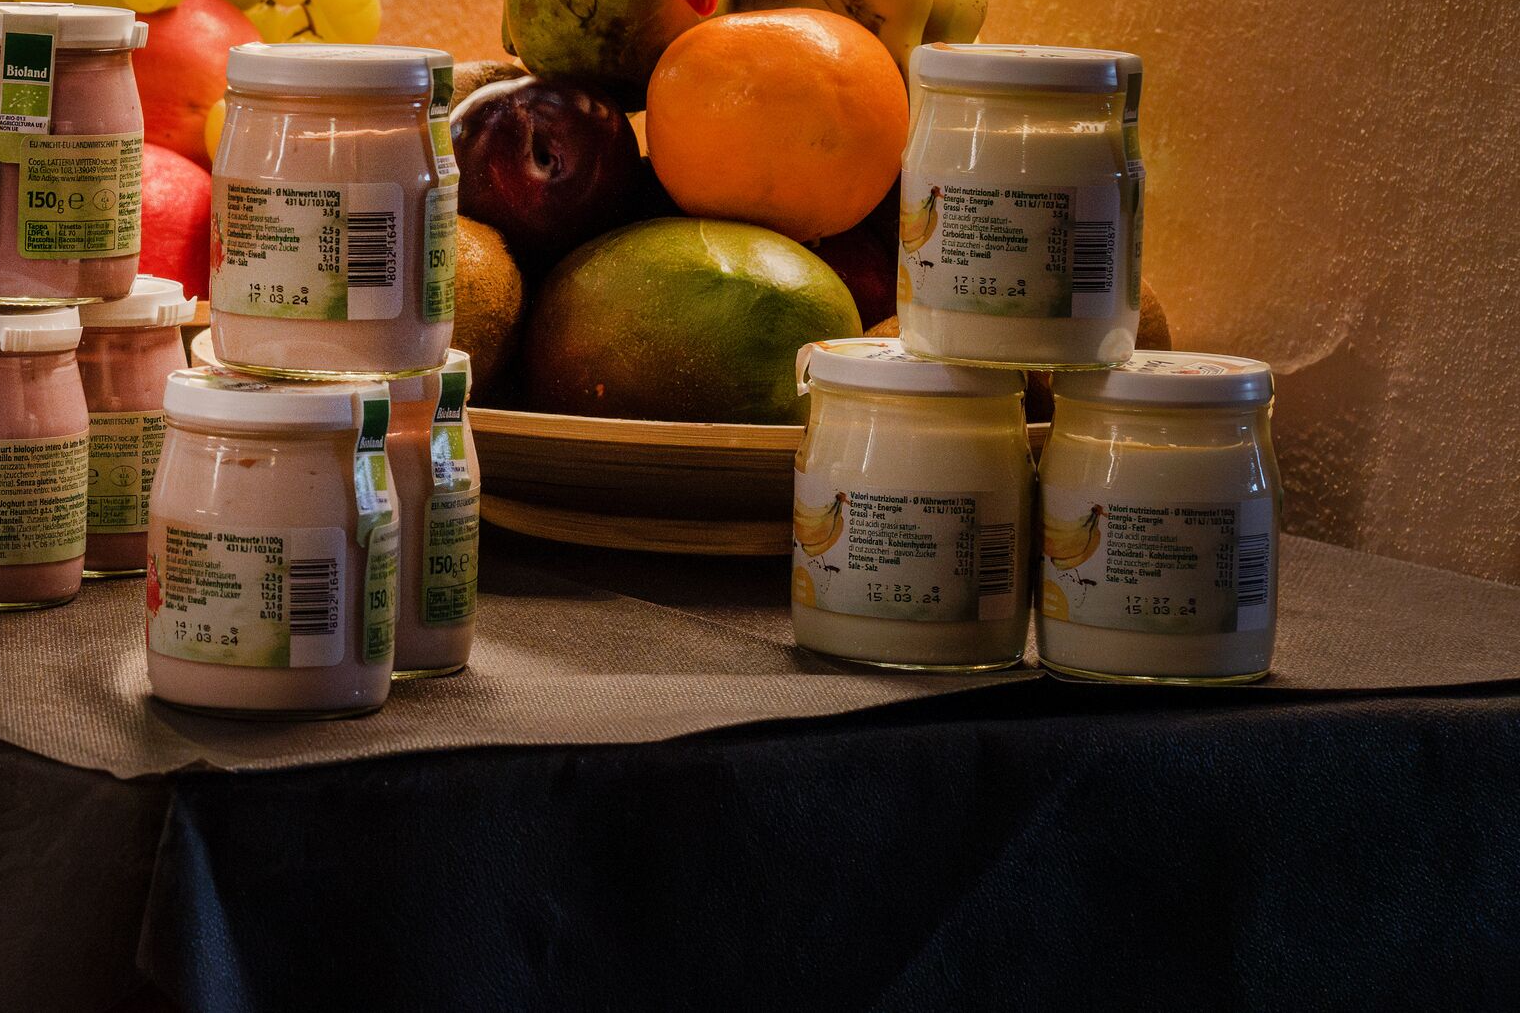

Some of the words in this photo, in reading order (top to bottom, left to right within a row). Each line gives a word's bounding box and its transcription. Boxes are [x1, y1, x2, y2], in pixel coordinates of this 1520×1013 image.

[6, 65, 47, 79] Bioland
[282, 188, 317, 198] Nährwerte
[944, 186, 962, 194] Valori
[962, 187, 1000, 197] nutrizionali
[285, 198, 297, 206] 431
[944, 194, 965, 204] Energia
[970, 197, 994, 207] Energie
[322, 208, 334, 217] 3,5
[944, 204, 960, 212] Grassi
[964, 205, 977, 214] Fett
[942, 230, 975, 240] Carboidrati
[980, 233, 1028, 245] Kohlenhydrate
[942, 247, 965, 256] Proteine
[941, 256, 952, 264] Sale
[956, 258, 969, 266] Salz
[318, 263, 334, 272] 0,10
[953, 285, 1026, 297] 15.03.24
[248, 292, 309, 305] 17.03.24
[436, 406, 461, 420] Bioland
[143, 416, 162, 425] Yogurt
[14, 444, 44, 456] biologico
[46, 444, 61, 452] intero
[16, 478, 36, 487] Senza
[850, 491, 869, 500] Valori
[870, 493, 908, 504] nutrizionali
[850, 500, 873, 510] Energia
[878, 503, 902, 513] Energie
[1108, 504, 1128, 513] Valori
[850, 509, 868, 518] Grassi
[872, 512, 885, 520] Fett
[1108, 512, 1132, 523] Energia
[1138, 515, 1163, 526] Energie
[1108, 522, 1127, 530] Grassi
[1132, 524, 1146, 533] Fett
[849, 536, 883, 546] Carboidrati
[848, 552, 874, 563] Proteine
[1107, 548, 1144, 559] Carboidrati
[848, 562, 861, 570] Sale
[865, 563, 878, 572] Salz
[1106, 566, 1133, 576] Proteine
[1106, 575, 1120, 583] Sale
[1124, 576, 1138, 584] Salz
[866, 592, 941, 604] 15.03.24
[174, 630, 239, 646] 17.03.24
